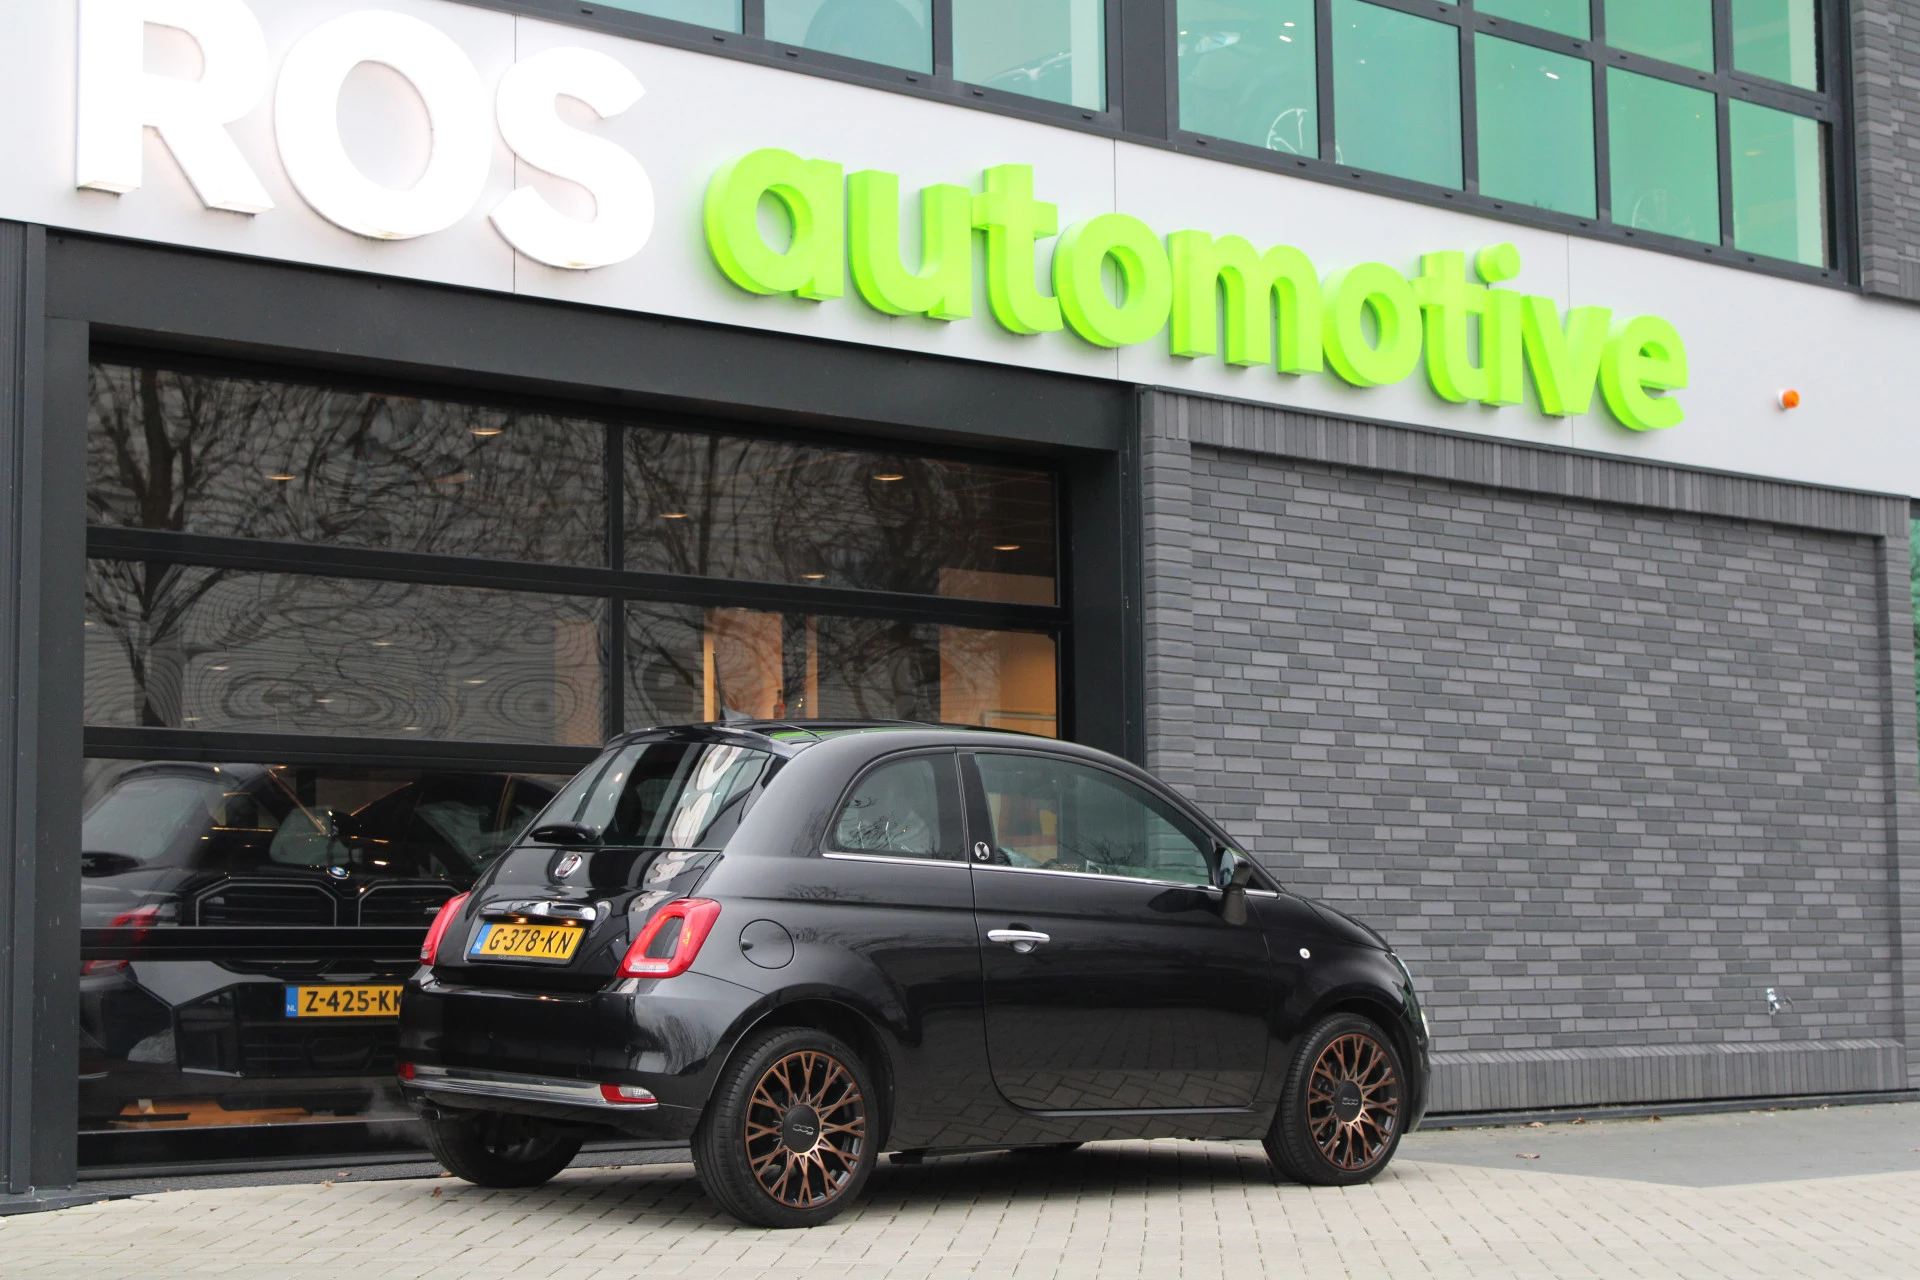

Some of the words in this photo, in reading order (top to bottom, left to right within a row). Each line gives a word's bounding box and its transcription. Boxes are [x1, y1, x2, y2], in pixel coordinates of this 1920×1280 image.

[76, 0, 655, 269] ROS
[703, 149, 1687, 430] automotive
[489, 928, 574, 954] G-378-KN
